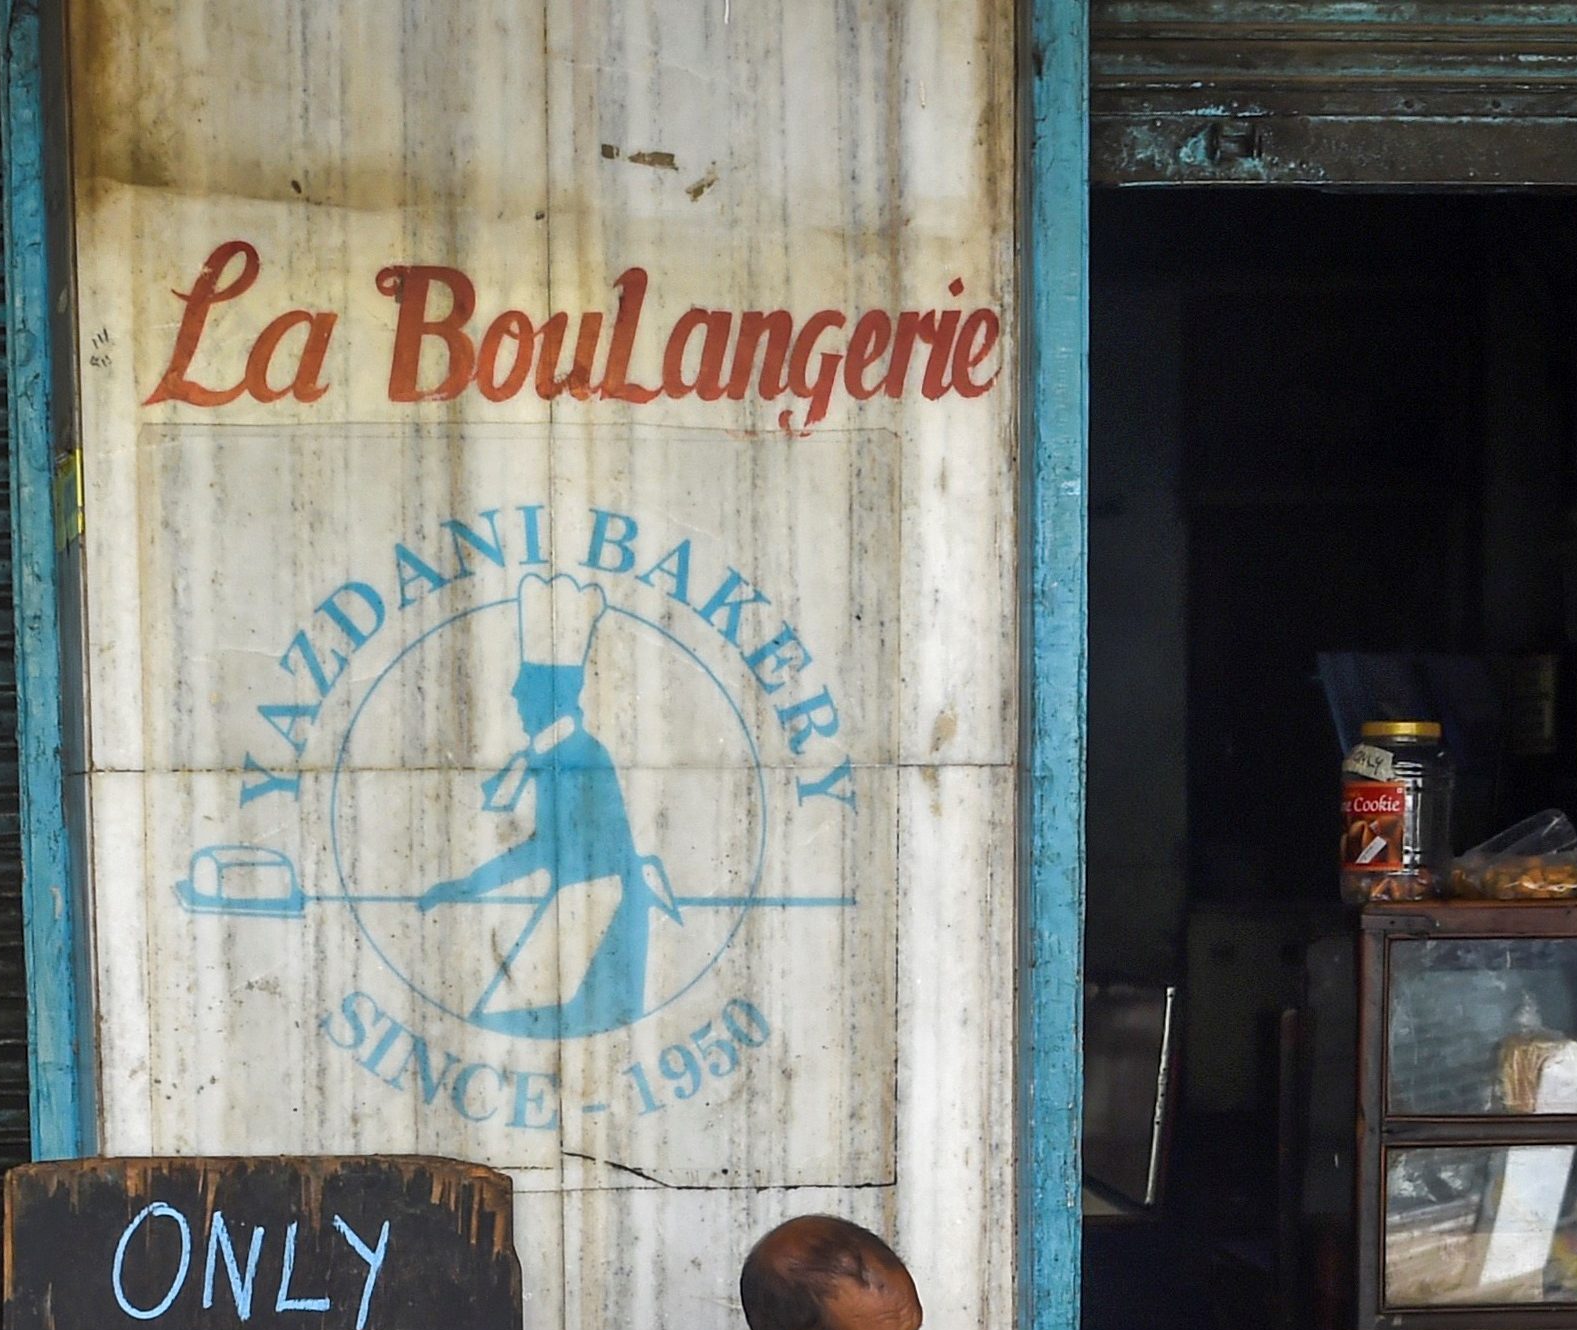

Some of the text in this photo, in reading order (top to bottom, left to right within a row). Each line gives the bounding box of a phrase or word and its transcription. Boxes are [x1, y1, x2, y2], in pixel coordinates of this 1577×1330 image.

[145, 240, 336, 408] La
[239, 504, 858, 810] YAZDANI BAKERY
[1353, 794, 1401, 812] Cookie
[320, 989, 560, 1132] SINCE
[624, 997, 773, 1117] 1950
